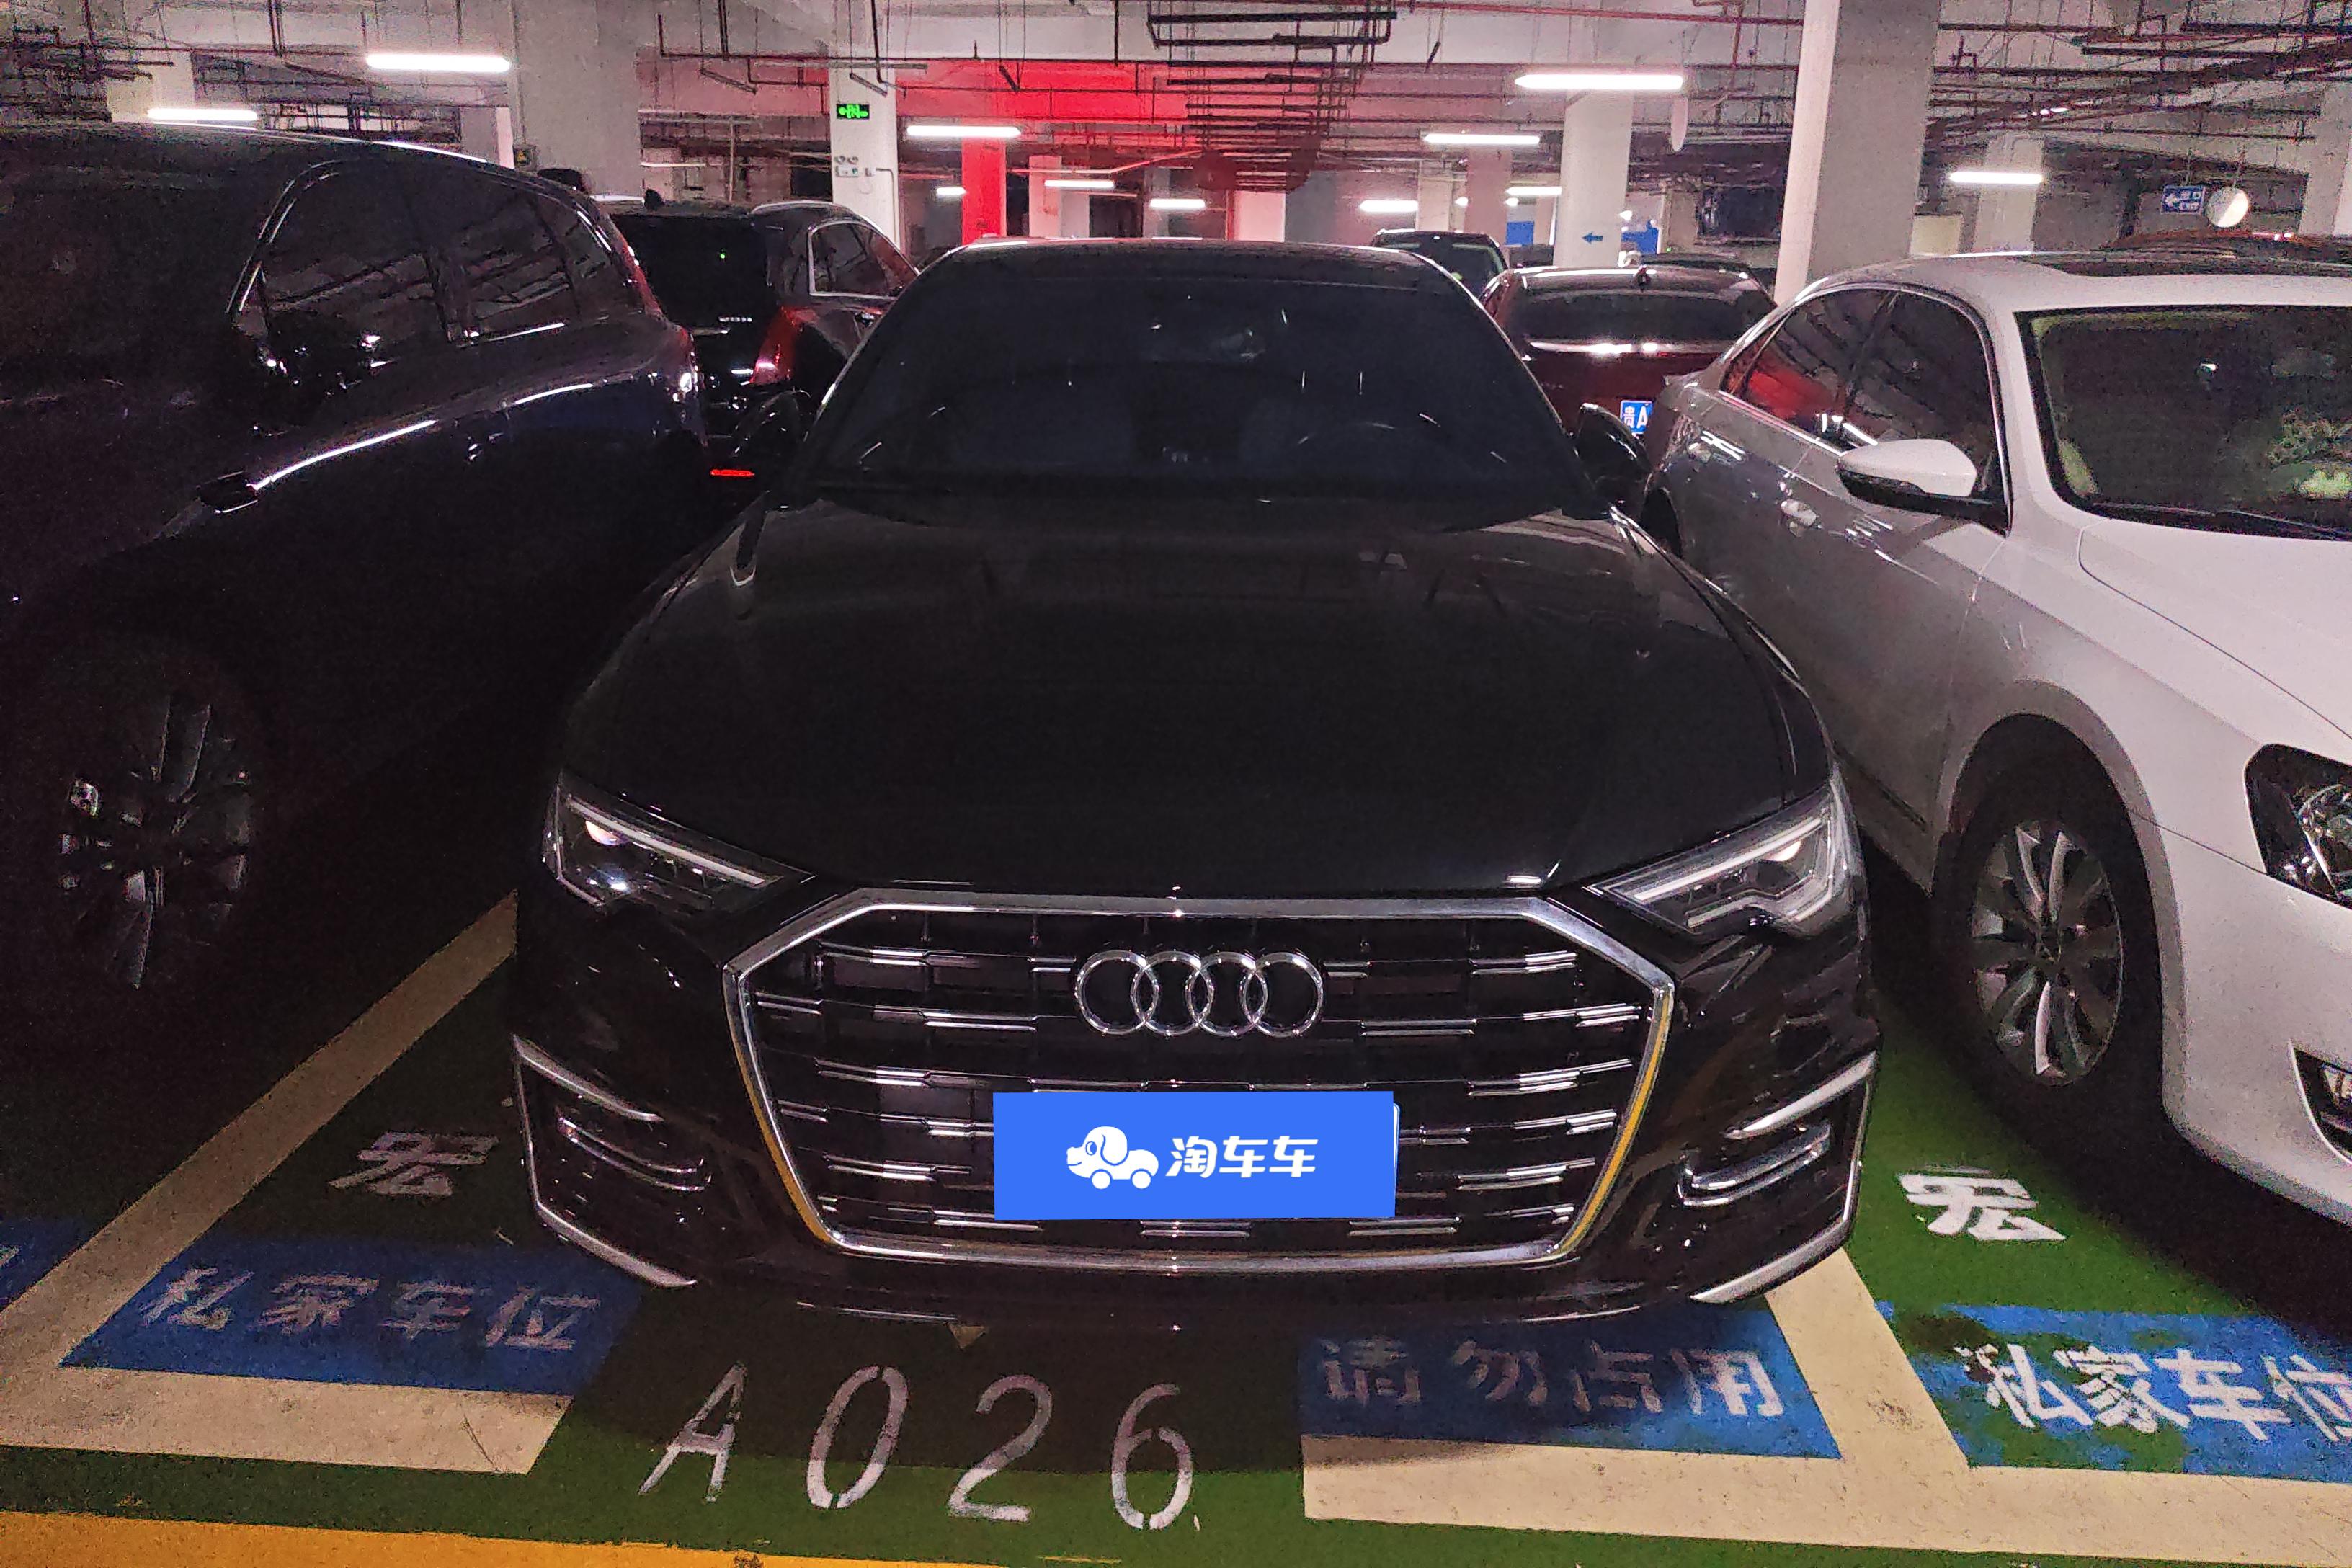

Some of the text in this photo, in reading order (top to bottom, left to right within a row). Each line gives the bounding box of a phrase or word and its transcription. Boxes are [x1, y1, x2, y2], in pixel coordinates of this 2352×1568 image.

[141, 1266, 601, 1352] 私家车位
[1319, 1335, 1785, 1417] 请勿占用
[638, 1361, 1194, 1531] A026
